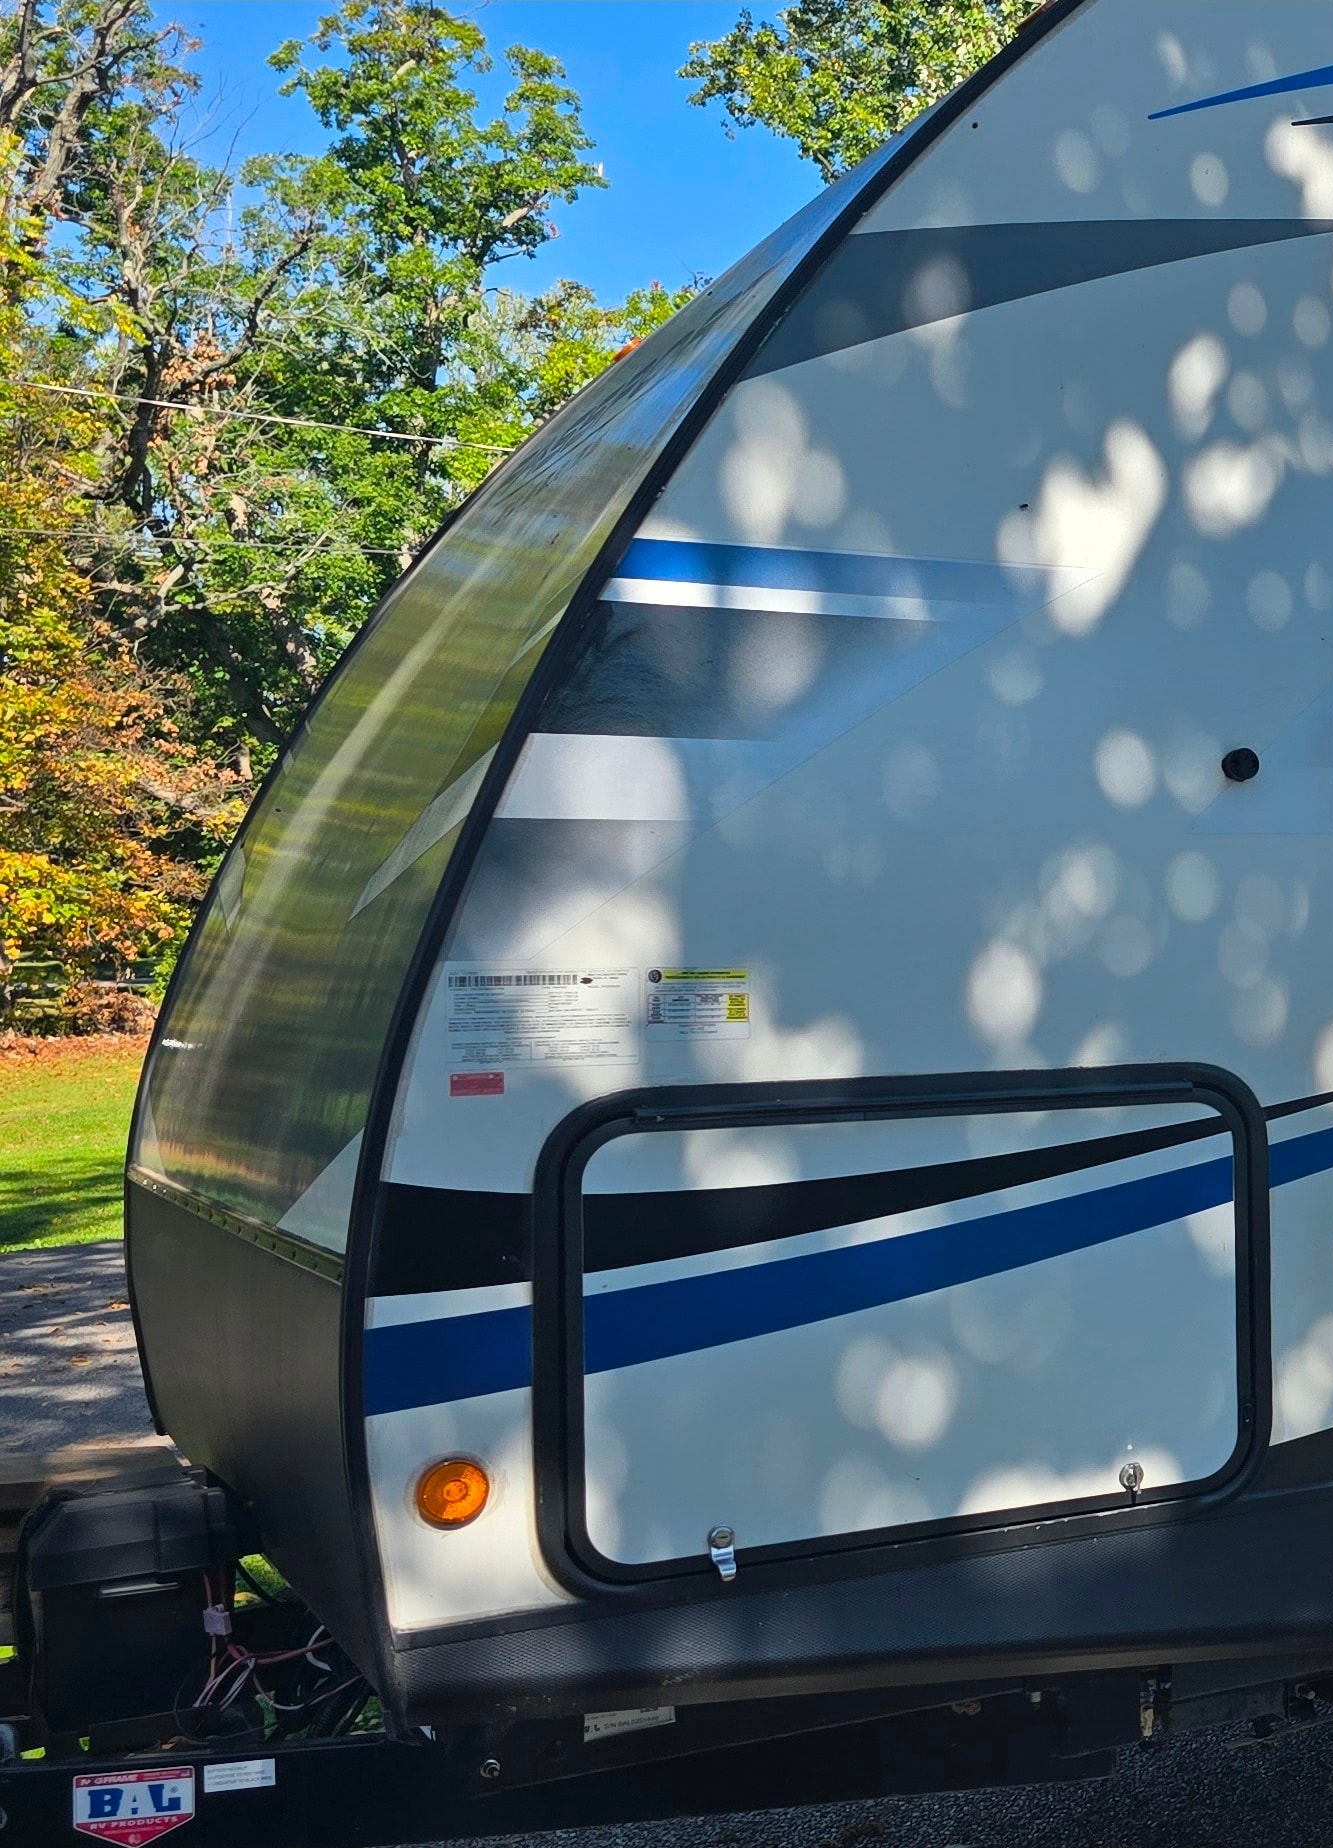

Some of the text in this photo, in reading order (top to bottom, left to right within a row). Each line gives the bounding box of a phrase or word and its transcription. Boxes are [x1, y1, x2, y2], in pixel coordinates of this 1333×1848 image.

[88, 1783, 181, 1819] BAL
[90, 1816, 179, 1830] RV PRODUCTS
